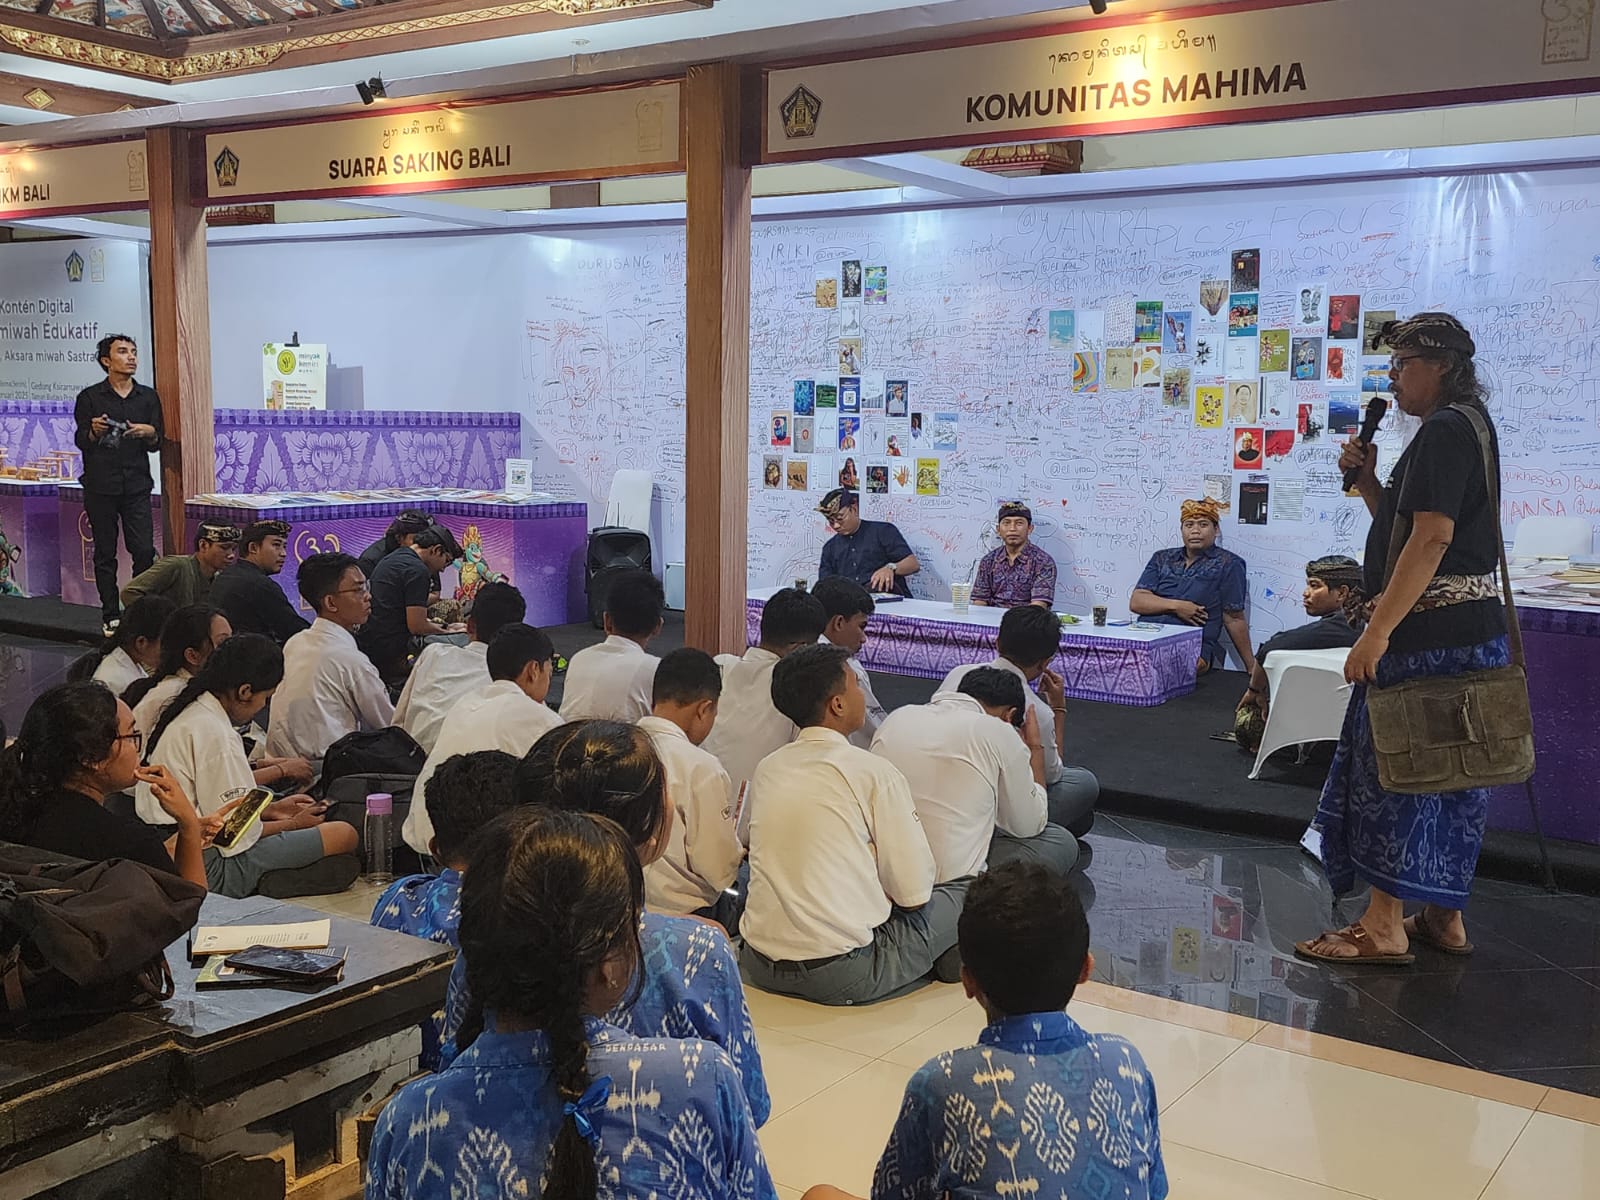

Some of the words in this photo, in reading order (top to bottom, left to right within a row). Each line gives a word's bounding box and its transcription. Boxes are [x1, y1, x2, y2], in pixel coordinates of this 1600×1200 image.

[966, 79, 1151, 123] KOMUNITAS
[1161, 61, 1307, 104] MAHIMA
[328, 155, 388, 180] SUARA
[393, 149, 464, 174] SAKING
[469, 145, 511, 169] BALI
[23, 184, 50, 202] BALI
[38, 298, 74, 316] Digital
[43, 319, 98, 339] Édukatif
[5, 350, 33, 361] Aksara
[36, 350, 65, 361] miwah
[67, 350, 95, 362] Sastra
[605, 1042, 667, 1053] DENPASAR
